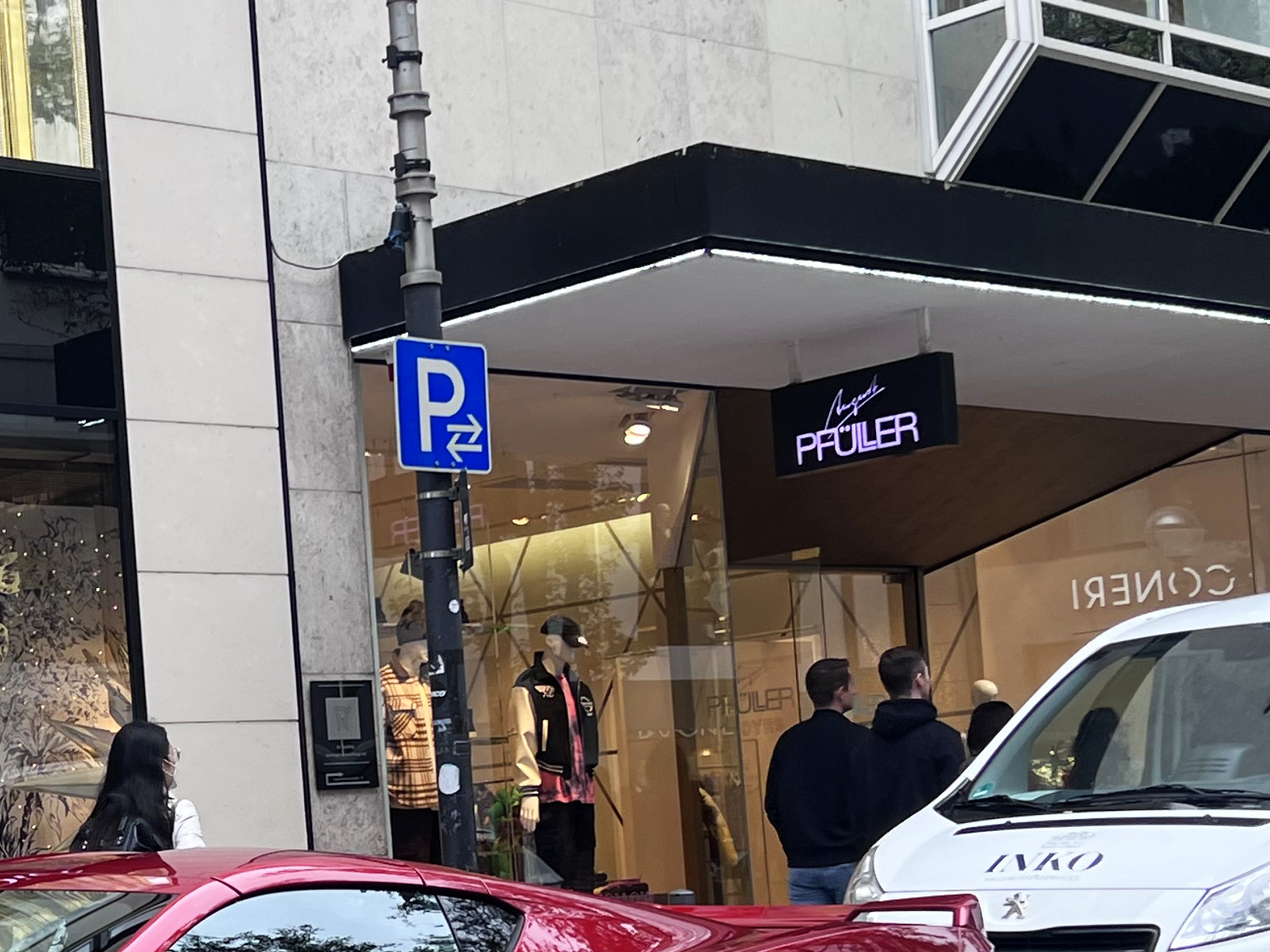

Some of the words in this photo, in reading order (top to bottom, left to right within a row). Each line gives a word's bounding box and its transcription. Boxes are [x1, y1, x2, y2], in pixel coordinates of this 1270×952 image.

[417, 357, 465, 453] P
[795, 411, 919, 466] PFÜLLER
[984, 850, 1104, 873] INKO
